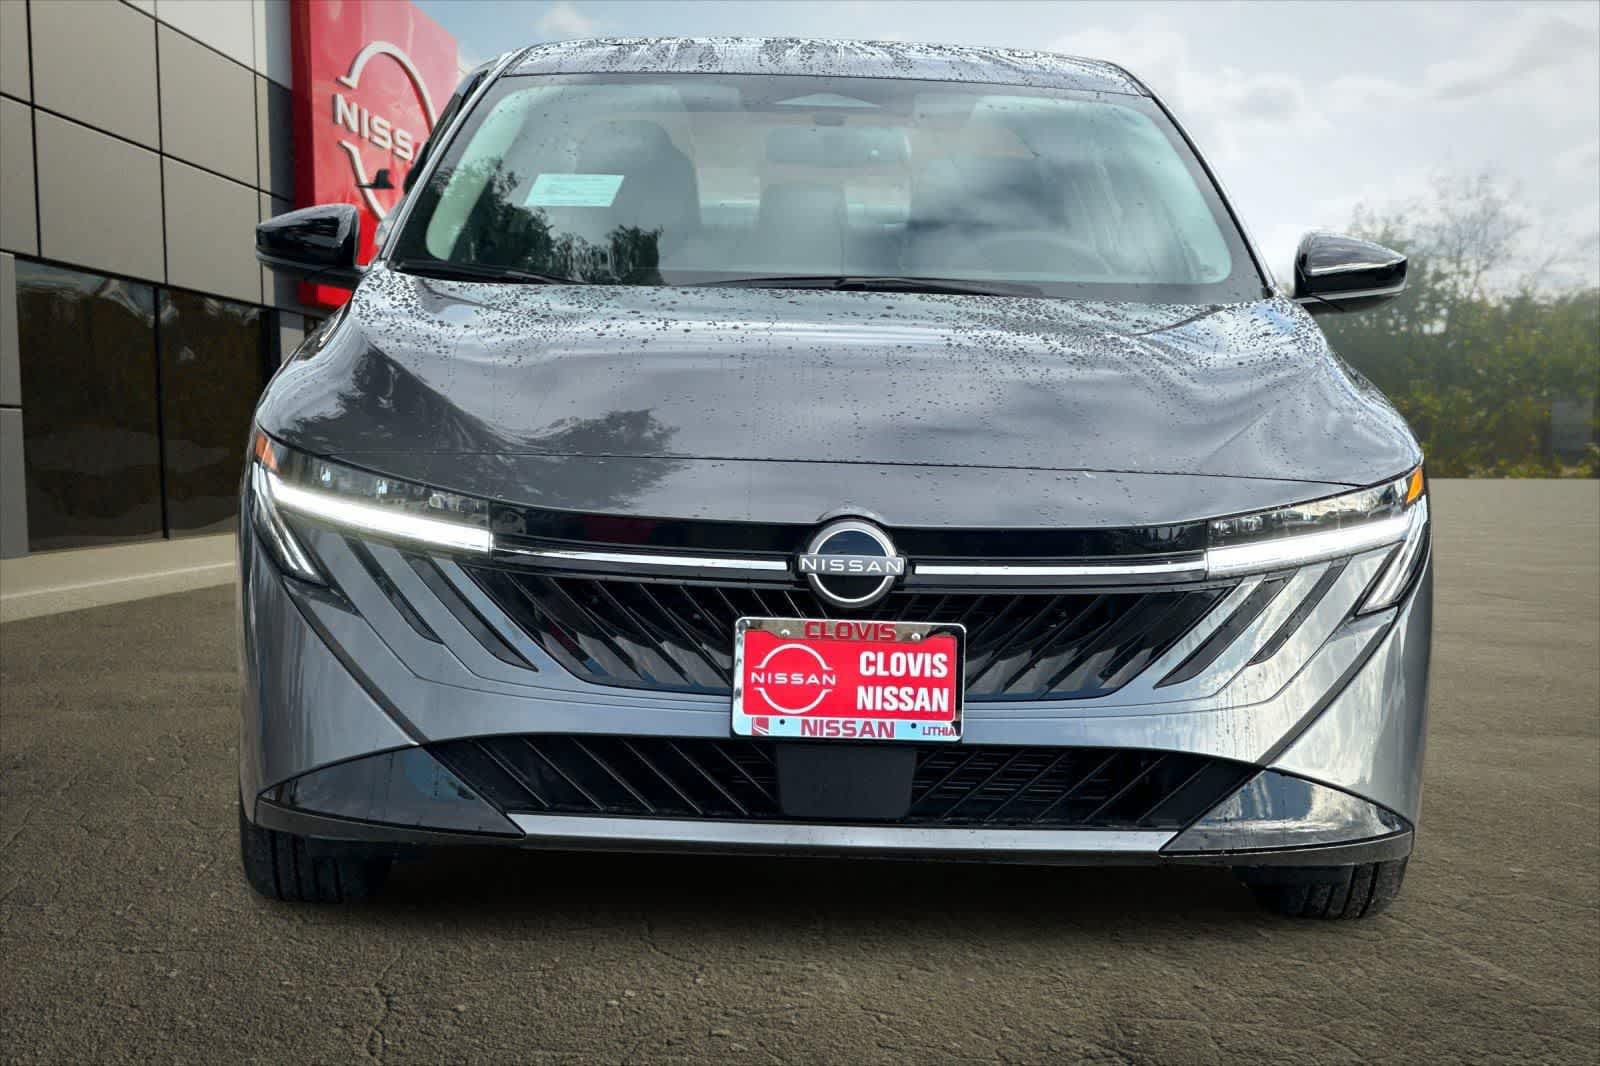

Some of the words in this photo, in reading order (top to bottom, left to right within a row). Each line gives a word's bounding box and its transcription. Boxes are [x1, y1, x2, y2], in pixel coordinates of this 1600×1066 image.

[801, 558, 901, 573] NISSAN
[803, 620, 897, 641] CLOVIS
[859, 651, 948, 678] CLOVIS
[751, 672, 837, 686] NISSAN
[856, 685, 949, 712] NISSAN
[800, 719, 895, 738] NISSAN
